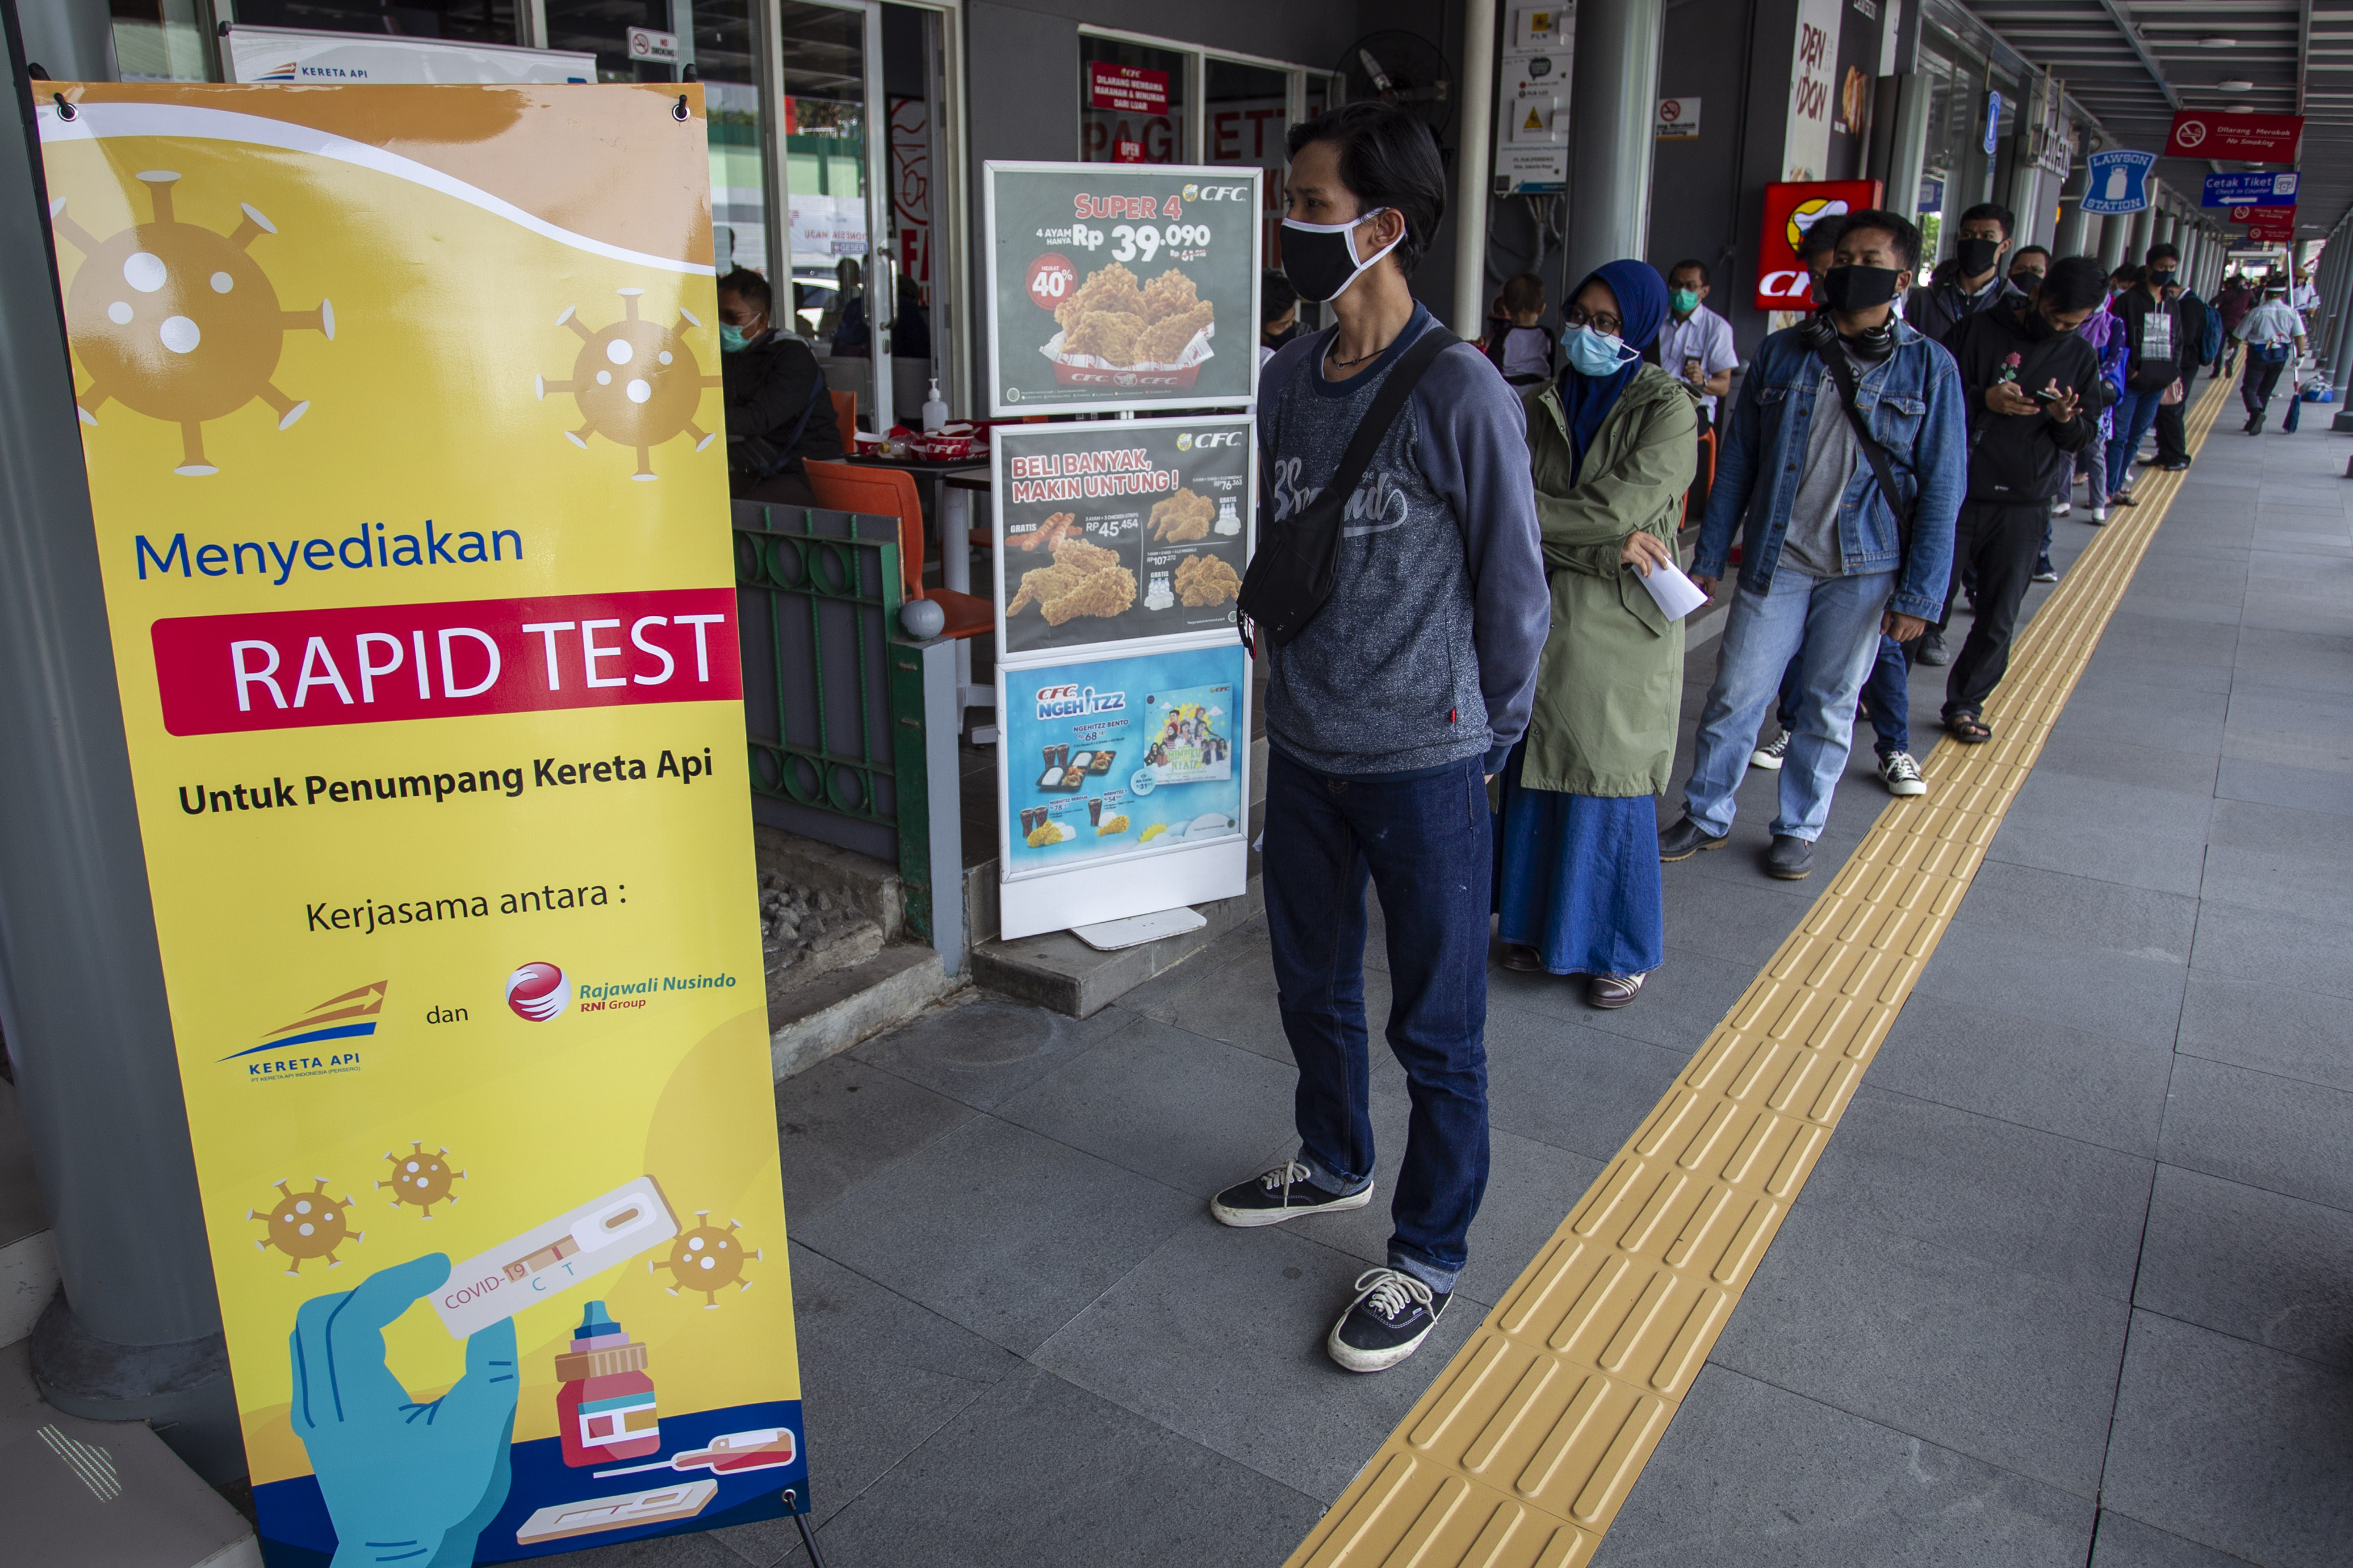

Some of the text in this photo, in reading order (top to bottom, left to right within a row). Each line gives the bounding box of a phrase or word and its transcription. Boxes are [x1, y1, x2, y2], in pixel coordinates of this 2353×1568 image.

[660, 38, 668, 47] NO
[302, 67, 368, 78] KERETA API
[1096, 75, 1164, 92] DILARANG MEMBAWA
[1095, 85, 1128, 98] MAKANAN
[1135, 91, 1166, 103] MINUMAN
[1114, 98, 1148, 111] DARI LUAR
[2217, 126, 2291, 136] Dilarang Merokok
[2240, 138, 2275, 148] Smoking
[2092, 153, 2149, 167] LAWSON
[2207, 178, 2272, 188] Cetak Tiket
[1200, 186, 1248, 202] CFC
[1074, 193, 1182, 221] SUPER 4
[2086, 198, 2141, 211] STATION
[1036, 223, 1211, 262] 4 AYAM Rp 39.090
[1046, 237, 1072, 245] HANYA
[1170, 249, 1179, 259] Rp
[1032, 269, 1074, 297] 40%
[1071, 372, 1109, 382] CFC
[1140, 376, 1178, 385] CFC
[1195, 431, 1242, 448] CFC
[1011, 448, 1152, 479] BELI BANYAK,
[1012, 476, 1082, 503] MAKIN
[1084, 470, 1169, 498] UNTUNG
[1011, 523, 1037, 533] GRATIS
[134, 520, 523, 586] Menyediakan
[231, 614, 725, 712] RAPID TEST
[1038, 686, 1076, 700] CFC
[1074, 719, 1129, 732] NGEHITZZ BENTO
[178, 747, 713, 815] Untuk Penumpang Kereta Api
[306, 895, 489, 936] Kerjasama
[500, 883, 609, 914] antara
[579, 973, 736, 1001] Rajawali Nusindo
[580, 999, 646, 1013] RNI Group
[426, 1005, 468, 1025] dan
[249, 1053, 360, 1075] KERETA API
[260, 1074, 285, 1082] KERETA
[295, 1070, 328, 1078] INDONESIA
[328, 1066, 361, 1075] (PERSERO)
[532, 1262, 574, 1292] C T
[445, 1263, 526, 1309] COVID-19
